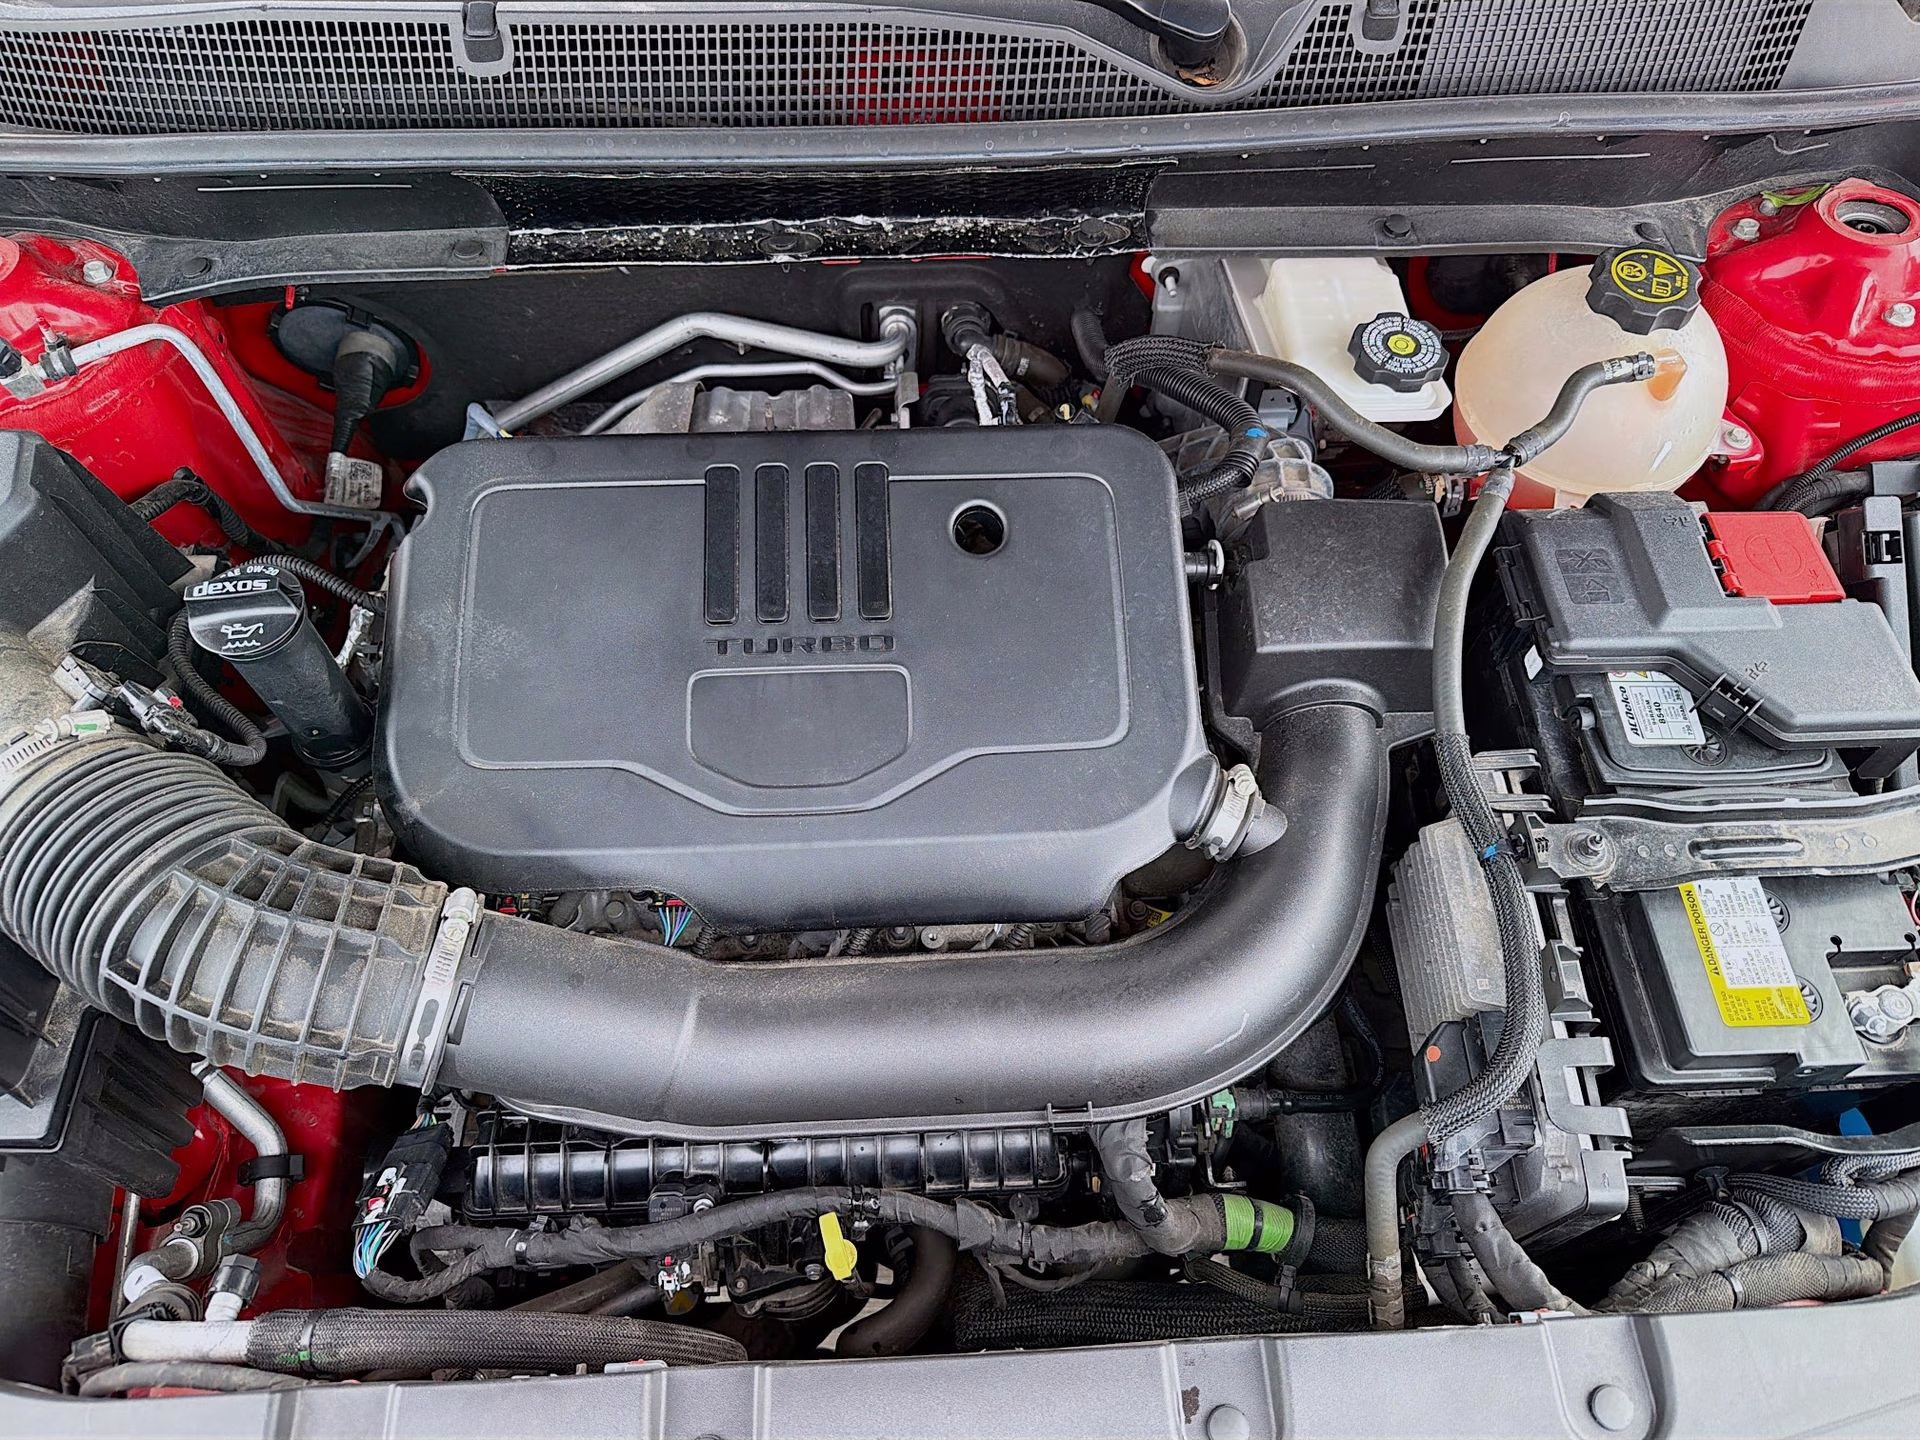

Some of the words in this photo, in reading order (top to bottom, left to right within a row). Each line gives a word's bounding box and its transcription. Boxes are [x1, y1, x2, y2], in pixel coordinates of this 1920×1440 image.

[246, 565, 280, 576] 0W-20
[192, 579, 271, 596] dexos
[703, 635, 896, 656] TURBO
[1619, 685, 1641, 737] ACDelco
[1652, 701, 1666, 723] 8540
[1684, 889, 1717, 966] DANGER/POISON
